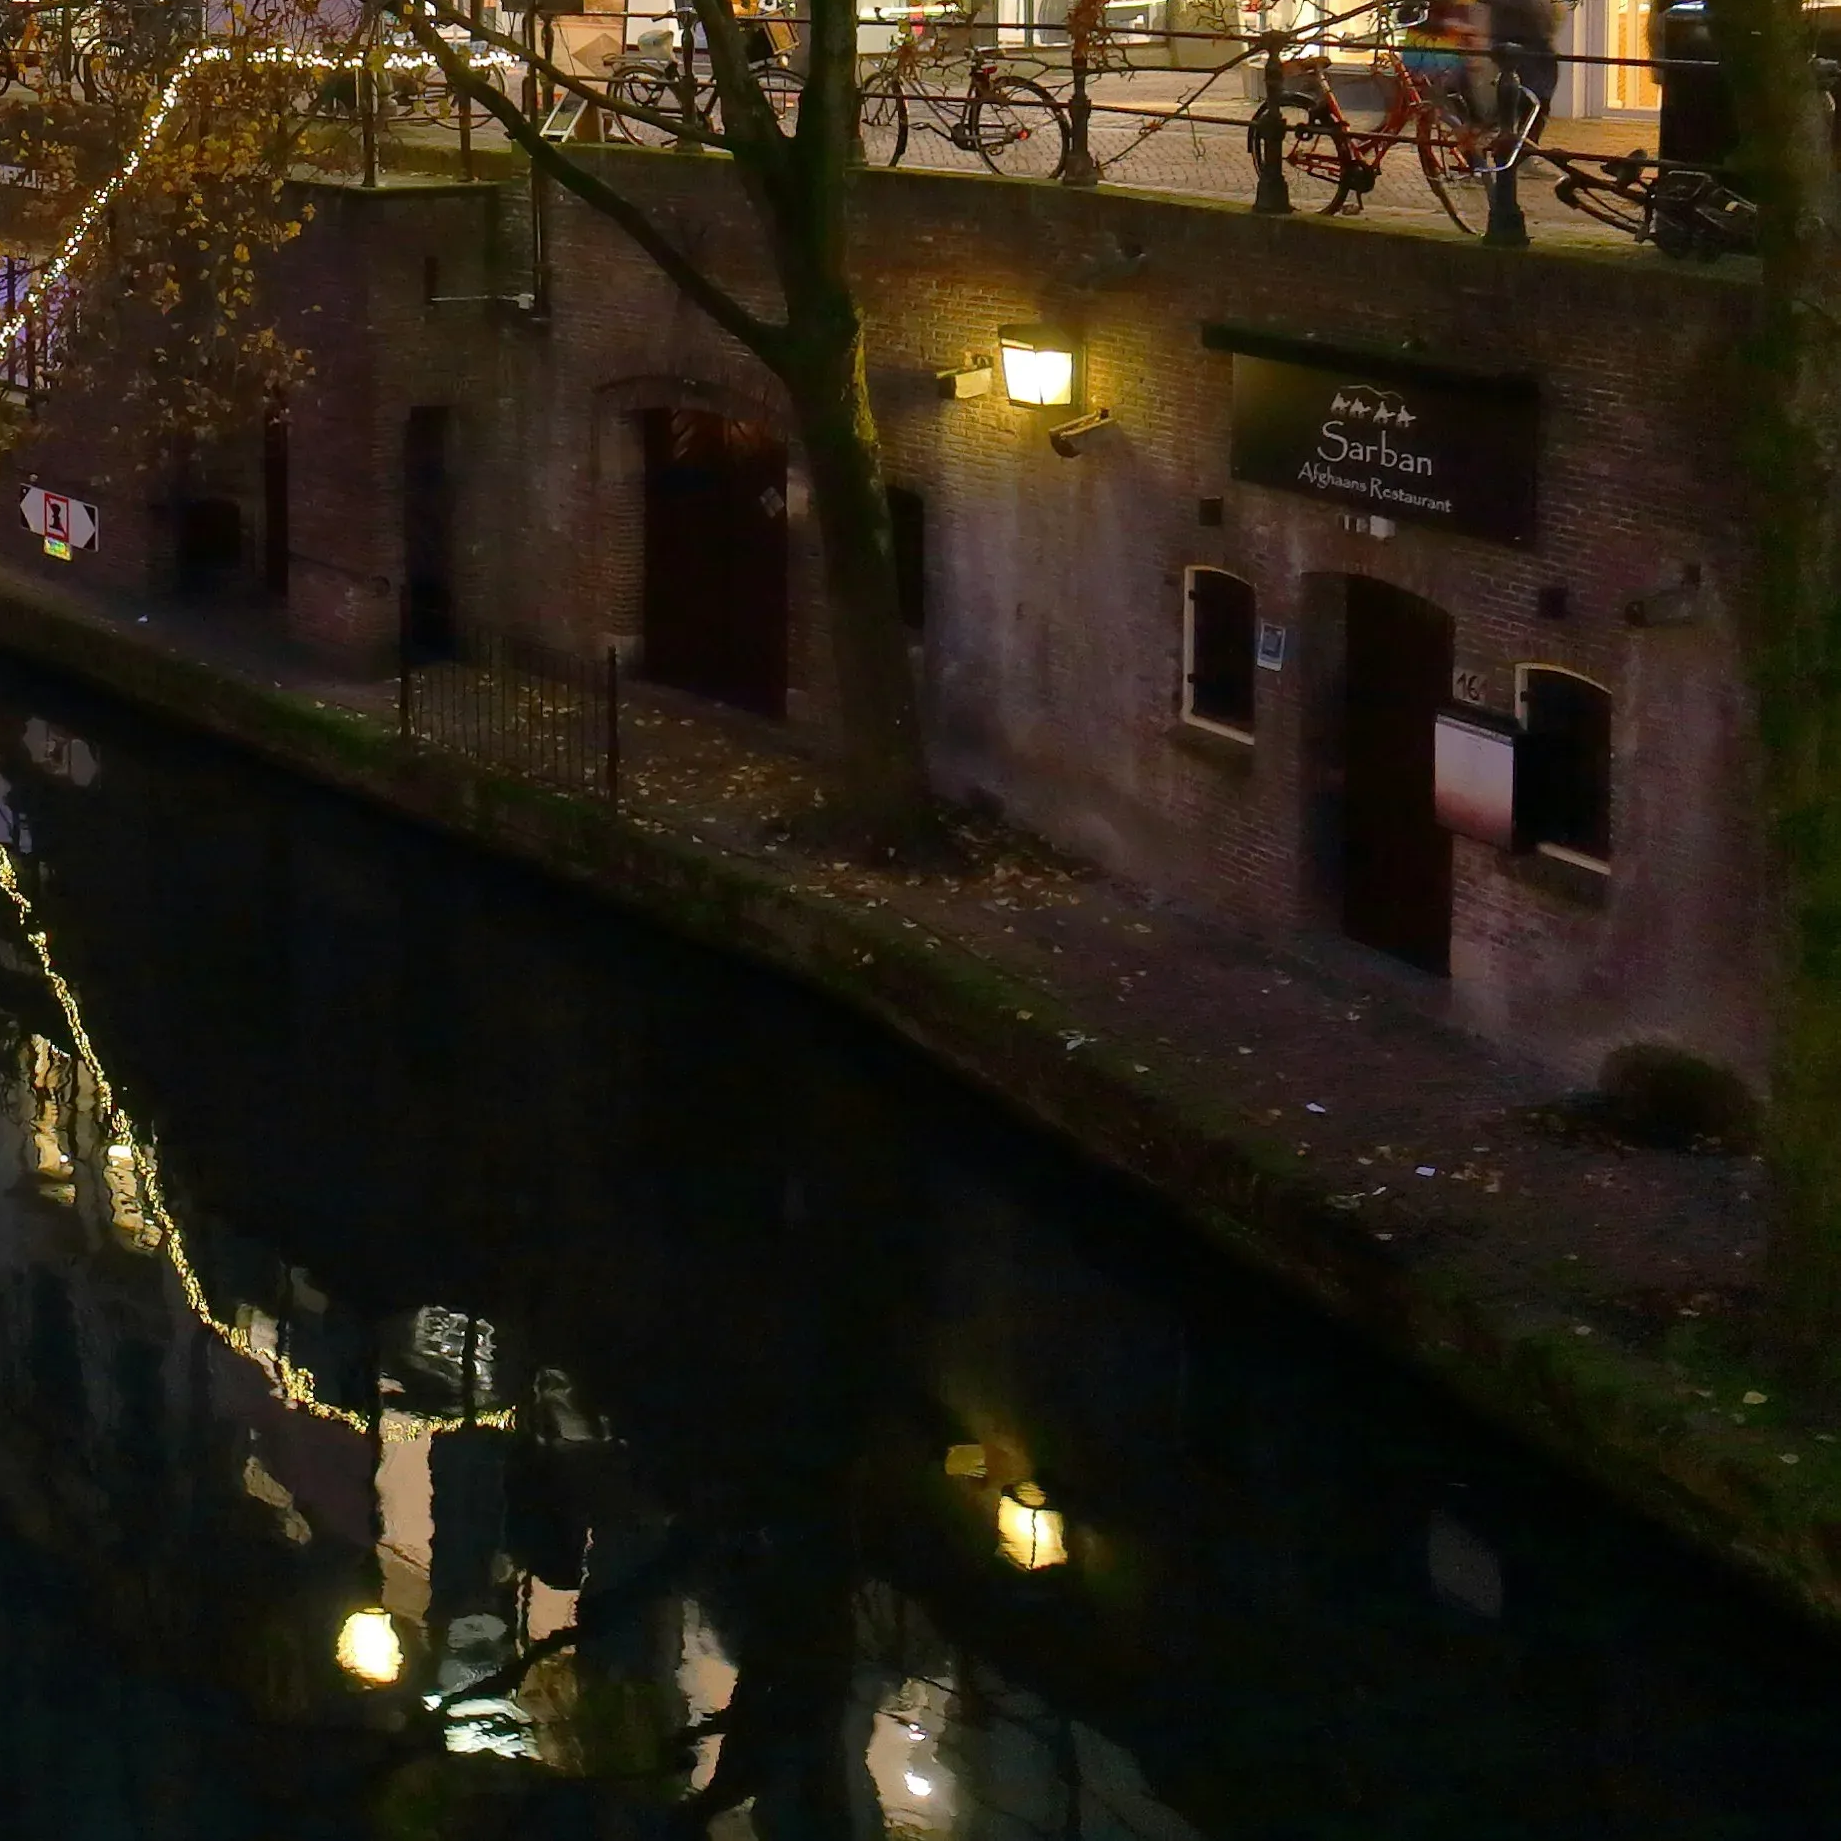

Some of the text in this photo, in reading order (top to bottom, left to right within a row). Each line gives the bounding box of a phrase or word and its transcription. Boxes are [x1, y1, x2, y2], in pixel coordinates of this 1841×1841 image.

[1317, 420, 1433, 475] Sarban
[1297, 461, 1453, 513] Afghaans Restaurant
